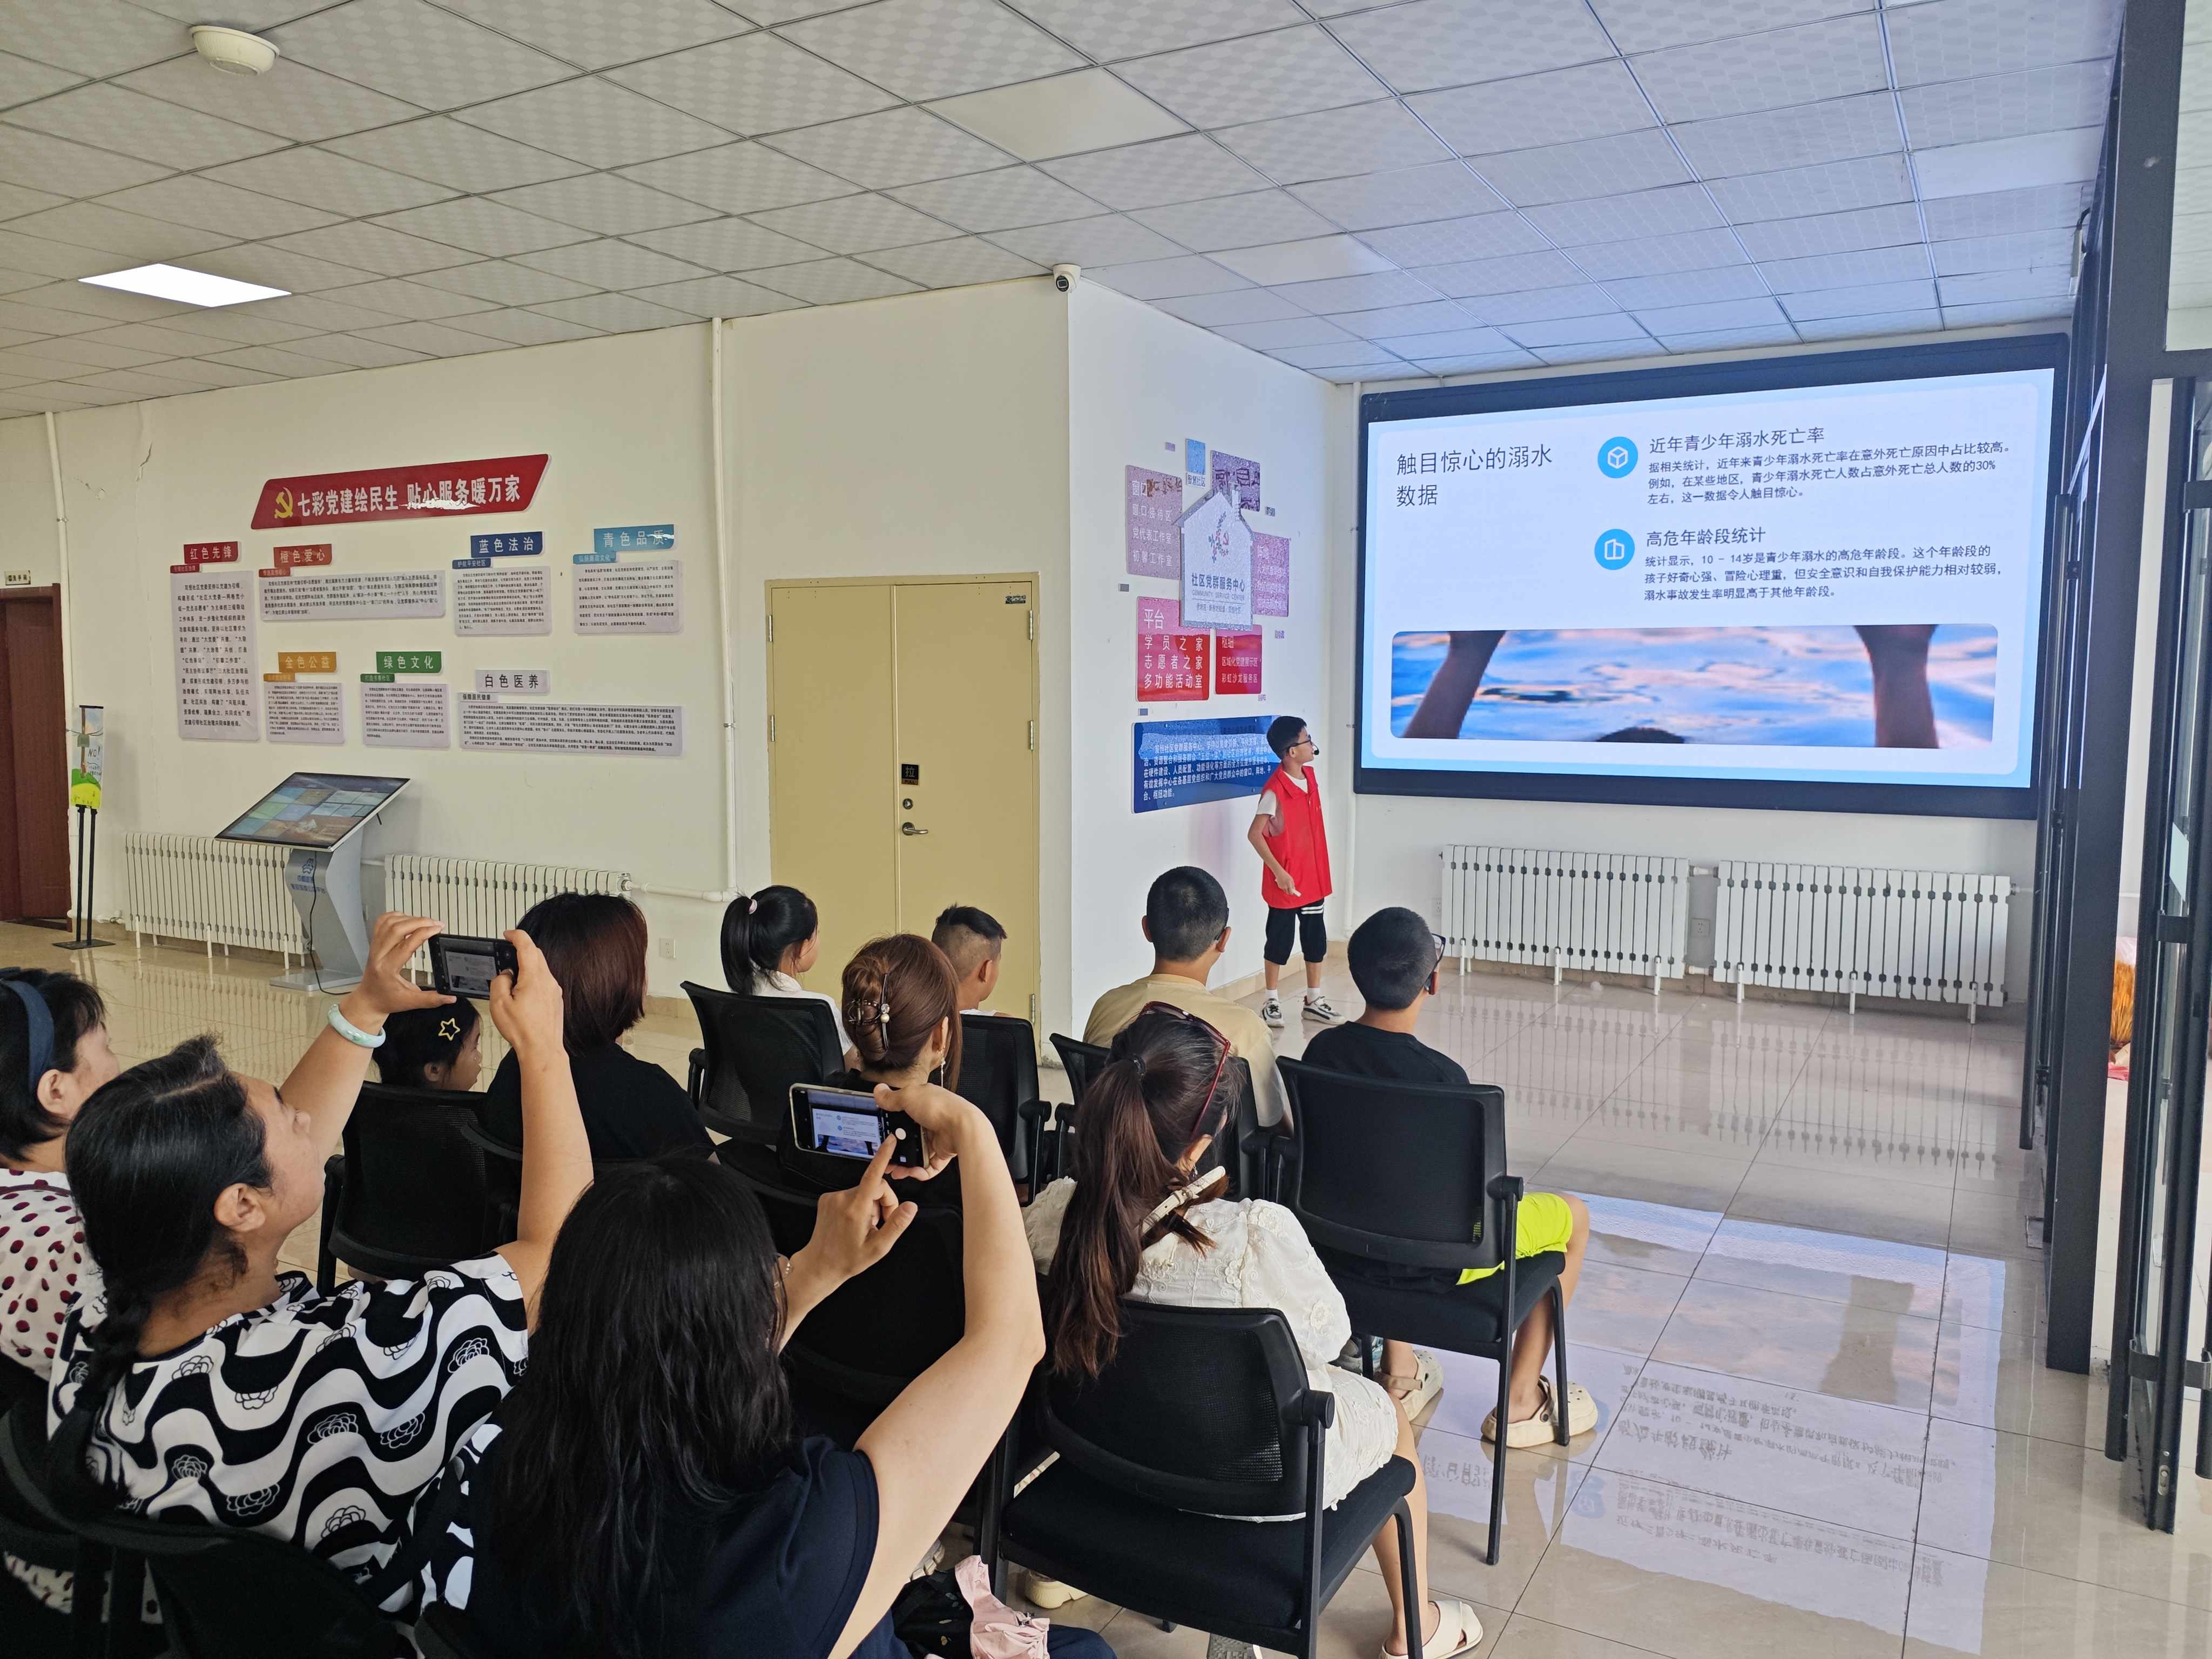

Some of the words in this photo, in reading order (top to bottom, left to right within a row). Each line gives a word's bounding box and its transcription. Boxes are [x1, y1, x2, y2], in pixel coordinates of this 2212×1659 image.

[1649, 427, 1824, 454] 近年青少年溺水死亡率
[1397, 444, 1553, 476] 触目惊心的溺水
[298, 484, 399, 517] 七彩党建绘民生
[407, 474, 521, 508] 贴心服务暖万家
[1397, 484, 1438, 507] 数据
[1647, 486, 1803, 505] 左右，这一数据令人触目惊心。
[478, 536, 534, 554] 蓝色法治
[603, 529, 664, 548] 青色品质
[1647, 527, 1766, 547] 高危年龄段统计
[190, 544, 232, 560] 红色先锋
[280, 548, 325, 564] 橙色爱心
[1191, 572, 1245, 592] 社区党群服务中心
[1644, 585, 1835, 601] 溺水事故发生率明显高于其他年龄段。
[1144, 609, 1164, 630] 平台
[1144, 634, 1203, 652] 学员之家
[285, 655, 331, 669] 金色公益
[383, 655, 434, 670] 绿色文化
[1144, 653, 1203, 670] 志愿者之家
[1222, 656, 1258, 667] 区域化党建展示区
[485, 674, 539, 689] 白色医养
[1144, 673, 1203, 689] 多功能活动室
[1222, 673, 1258, 684] 彩虹沙龙服务区
[906, 766, 915, 778] 拉
